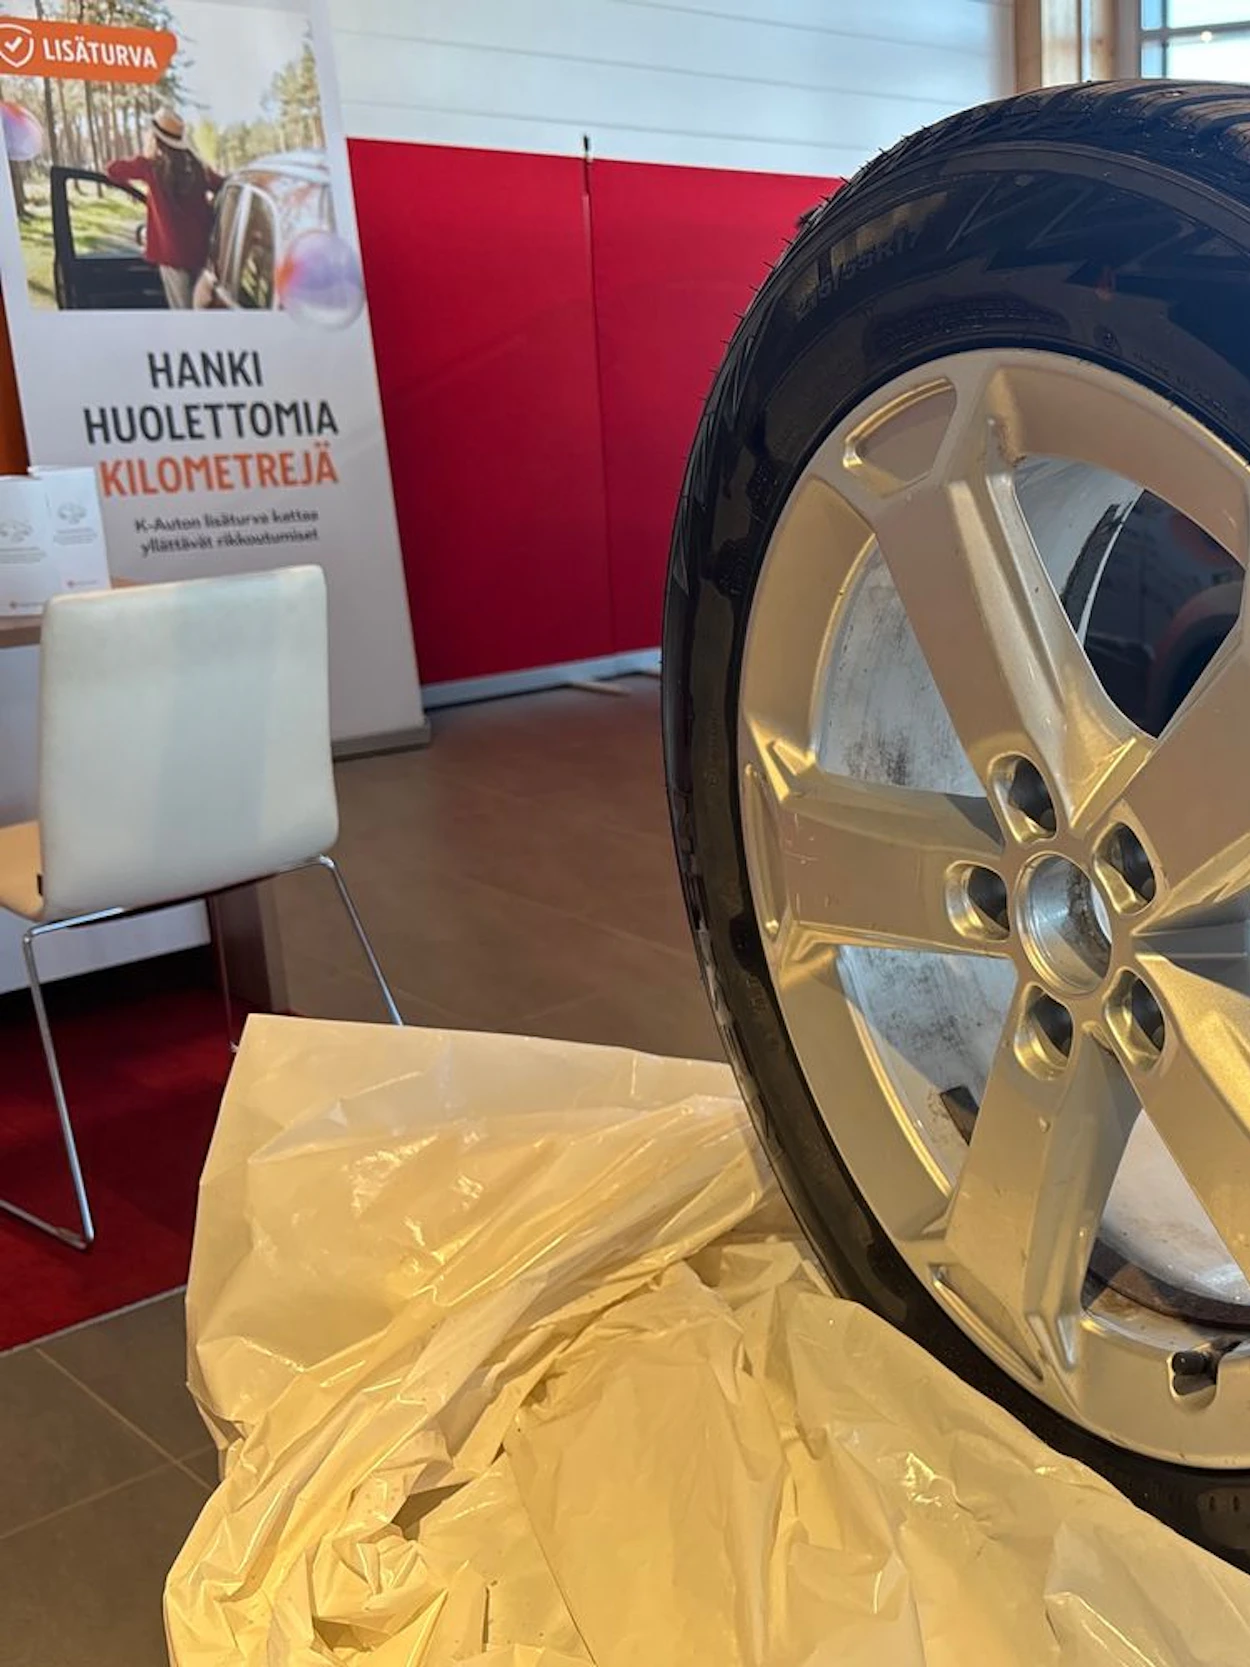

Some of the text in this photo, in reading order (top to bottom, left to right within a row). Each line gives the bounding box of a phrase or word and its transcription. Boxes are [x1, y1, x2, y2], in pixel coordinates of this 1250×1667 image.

[42, 35, 158, 69] LISÄTURVA
[148, 351, 263, 388] HANKI
[83, 400, 339, 444] HUOLETTOMIA
[99, 440, 339, 498] KILOMETREJÄ
[134, 508, 319, 533] K-Auton lisäturva kattaa
[140, 528, 318, 558] yllättävät rikkoutumiset
